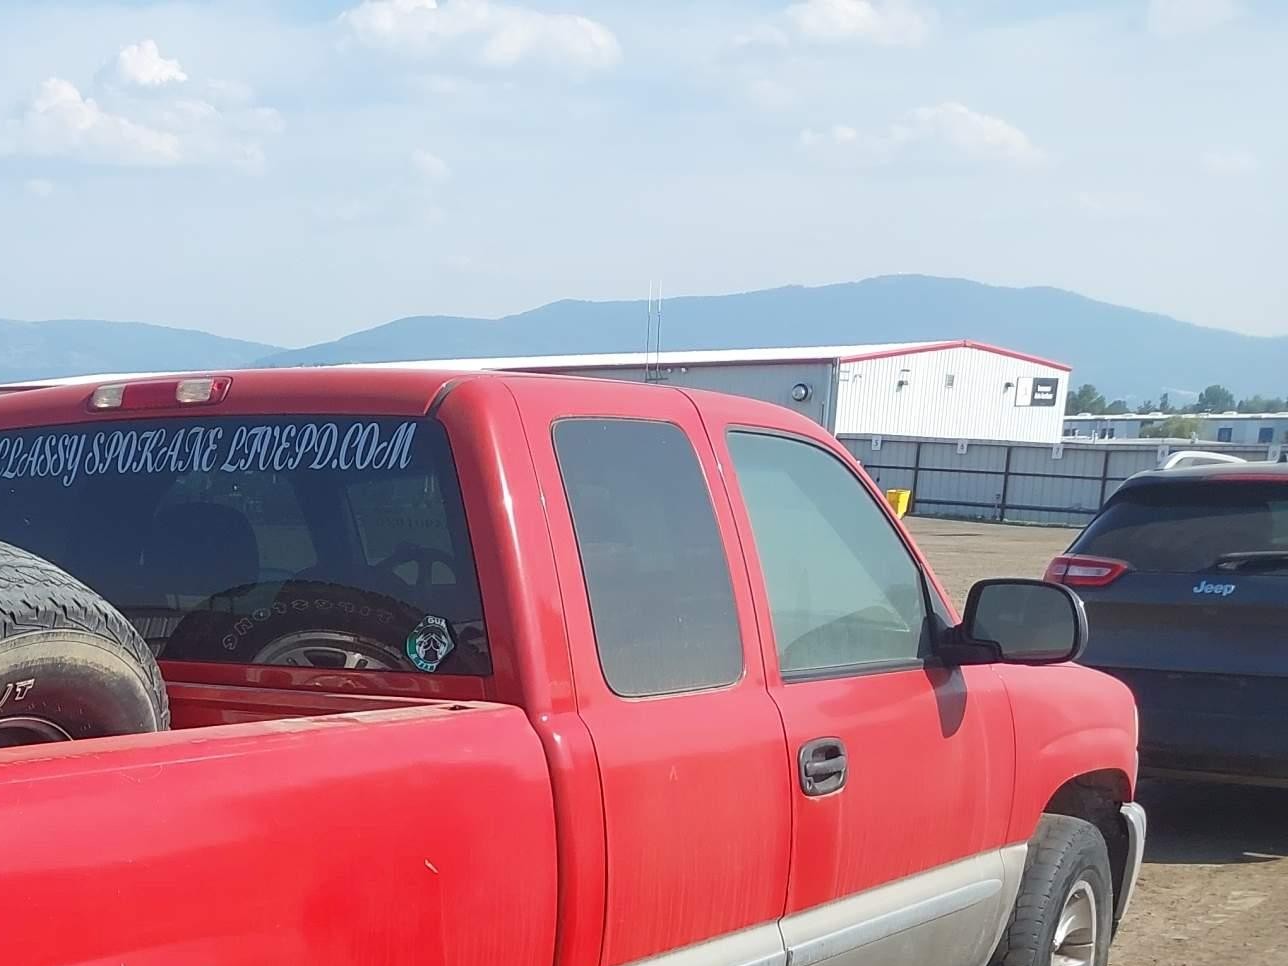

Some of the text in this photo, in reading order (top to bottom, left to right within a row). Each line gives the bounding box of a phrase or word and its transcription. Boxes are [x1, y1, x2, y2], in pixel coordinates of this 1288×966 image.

[85, 427, 223, 475] SPOKANE
[220, 422, 417, 473] LIVEPD.COM
[1193, 580, 1236, 597] Jeep
